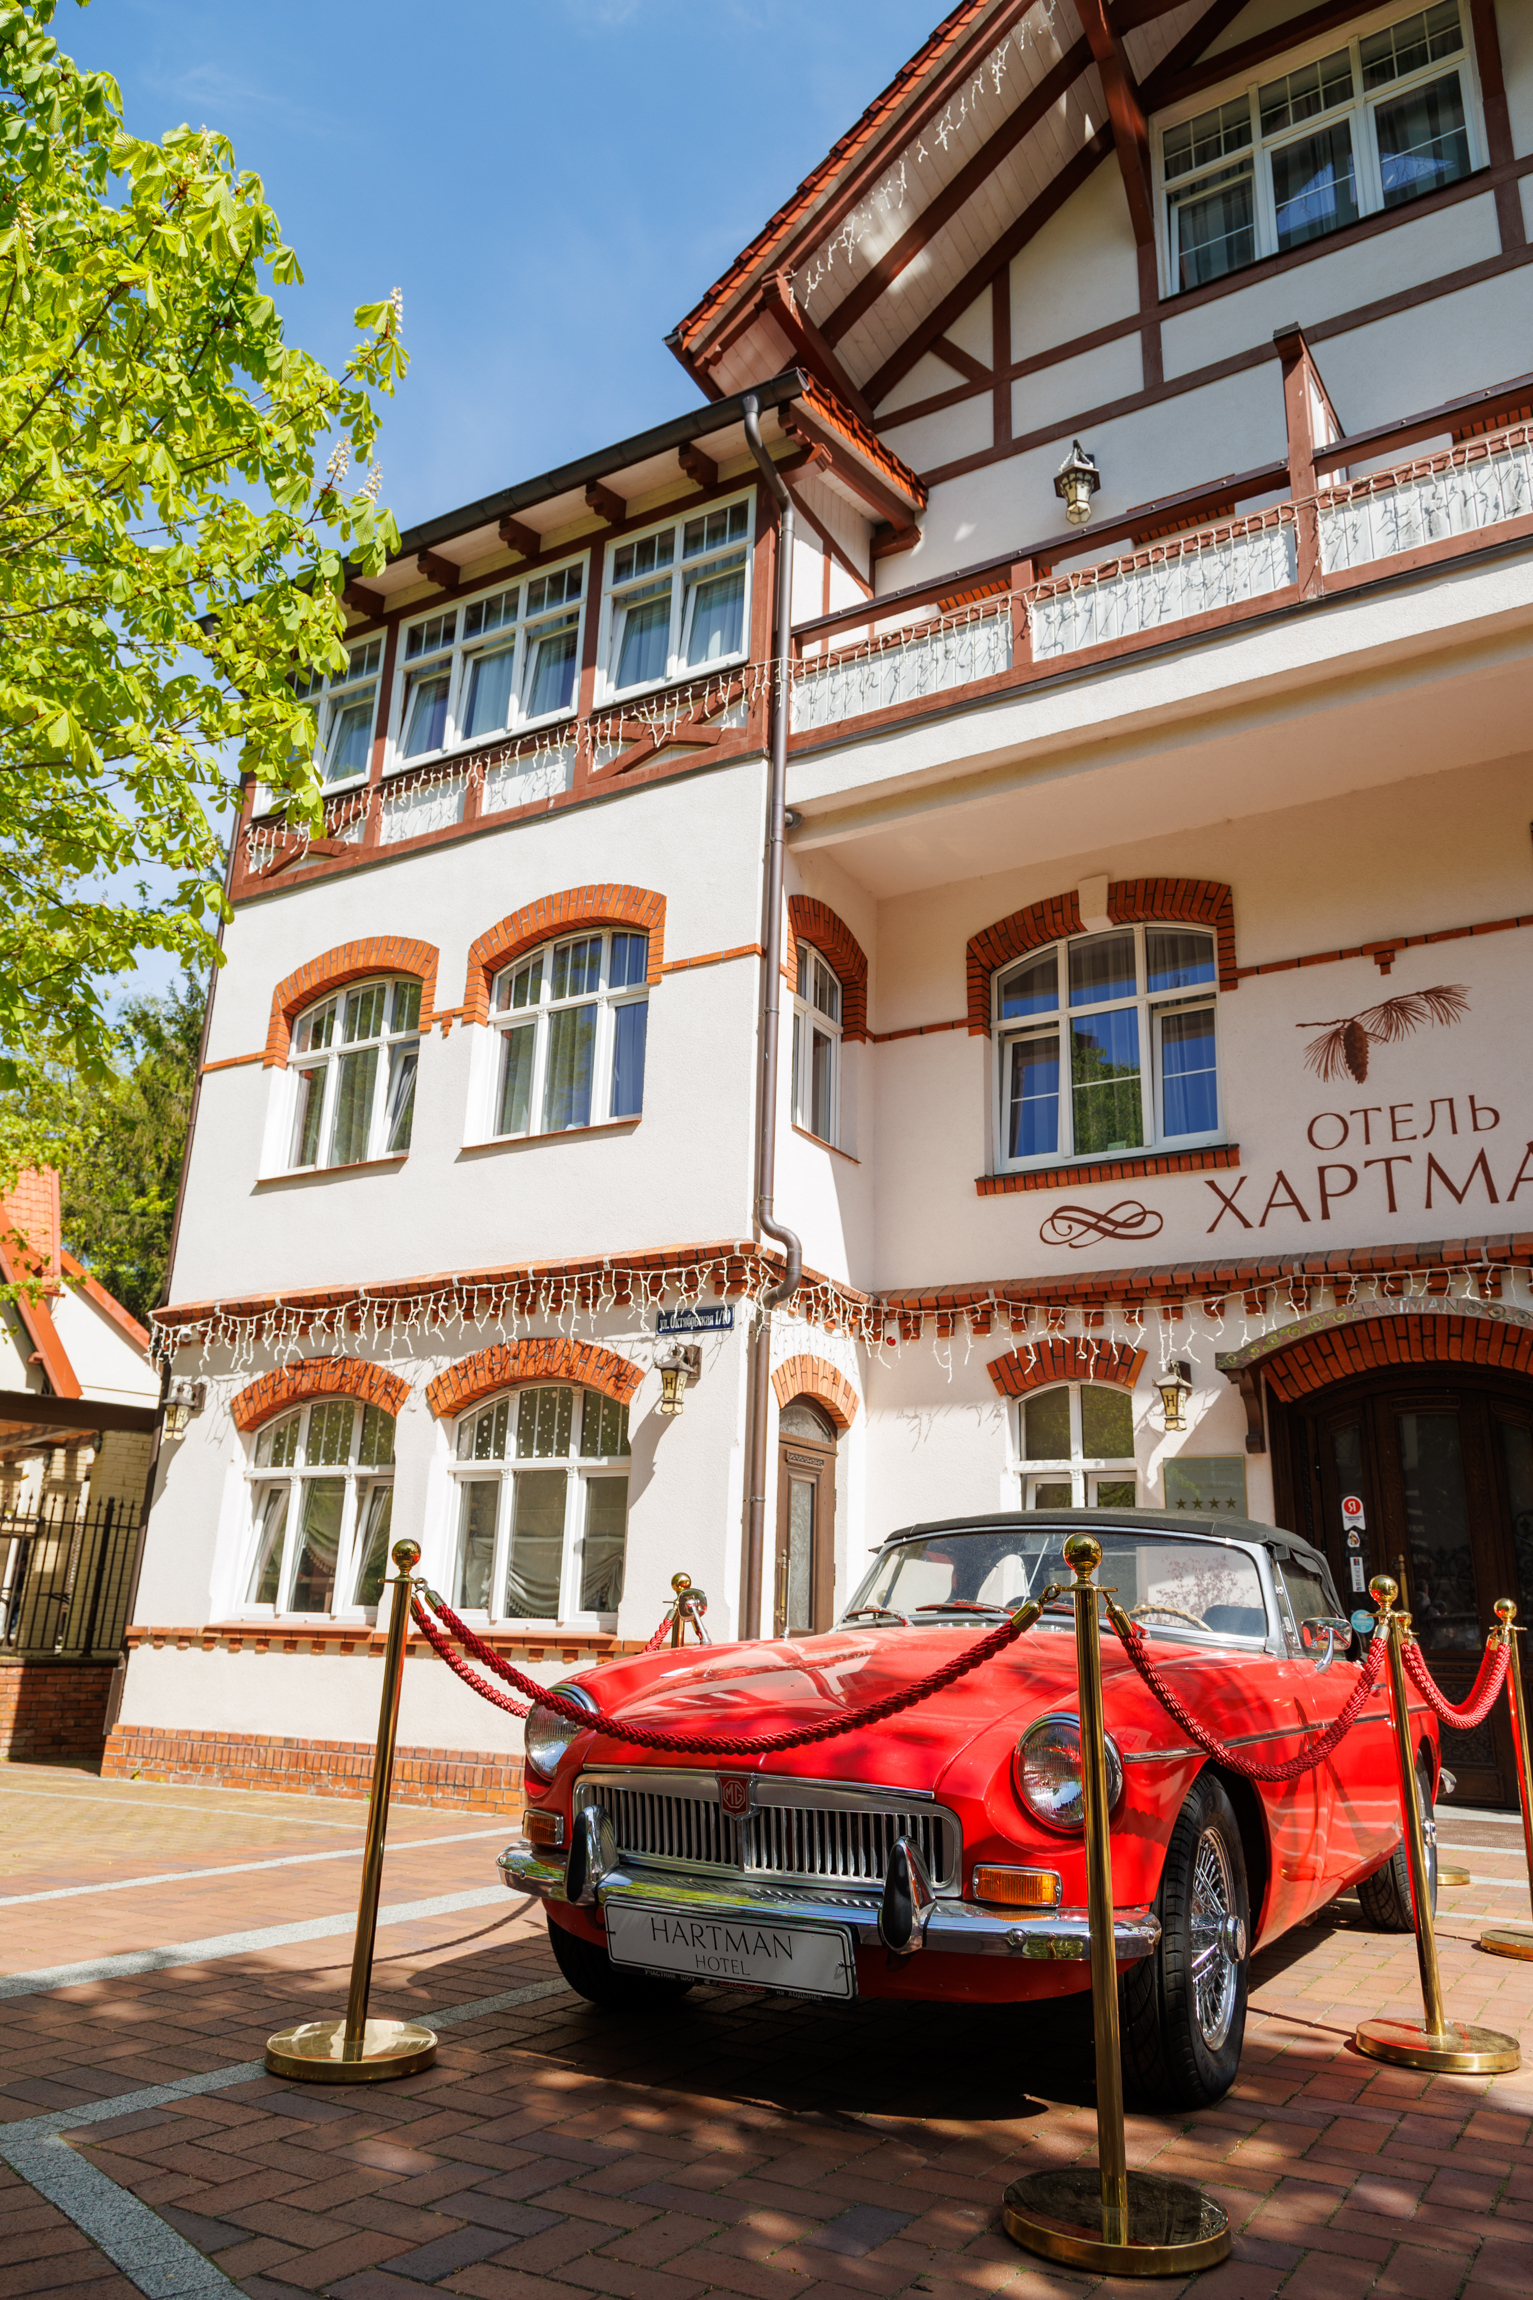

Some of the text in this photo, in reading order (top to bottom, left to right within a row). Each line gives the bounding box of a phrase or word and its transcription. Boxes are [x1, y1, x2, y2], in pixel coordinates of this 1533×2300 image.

[1307, 1095, 1500, 1150] ОТЕЛЬ
[1351, 1297, 1459, 1320] HARTMAN
[659, 1318, 670, 1332] ул.
[725, 1783, 743, 1806] MG
[651, 1917, 793, 1960] HARTMAN
[695, 1954, 751, 1976] HOTEL
[644, 1968, 677, 1979] УЧАСТНИК
[680, 1974, 695, 1982] ШОУ
[788, 1990, 823, 2001] ХОДЫНКЕ
